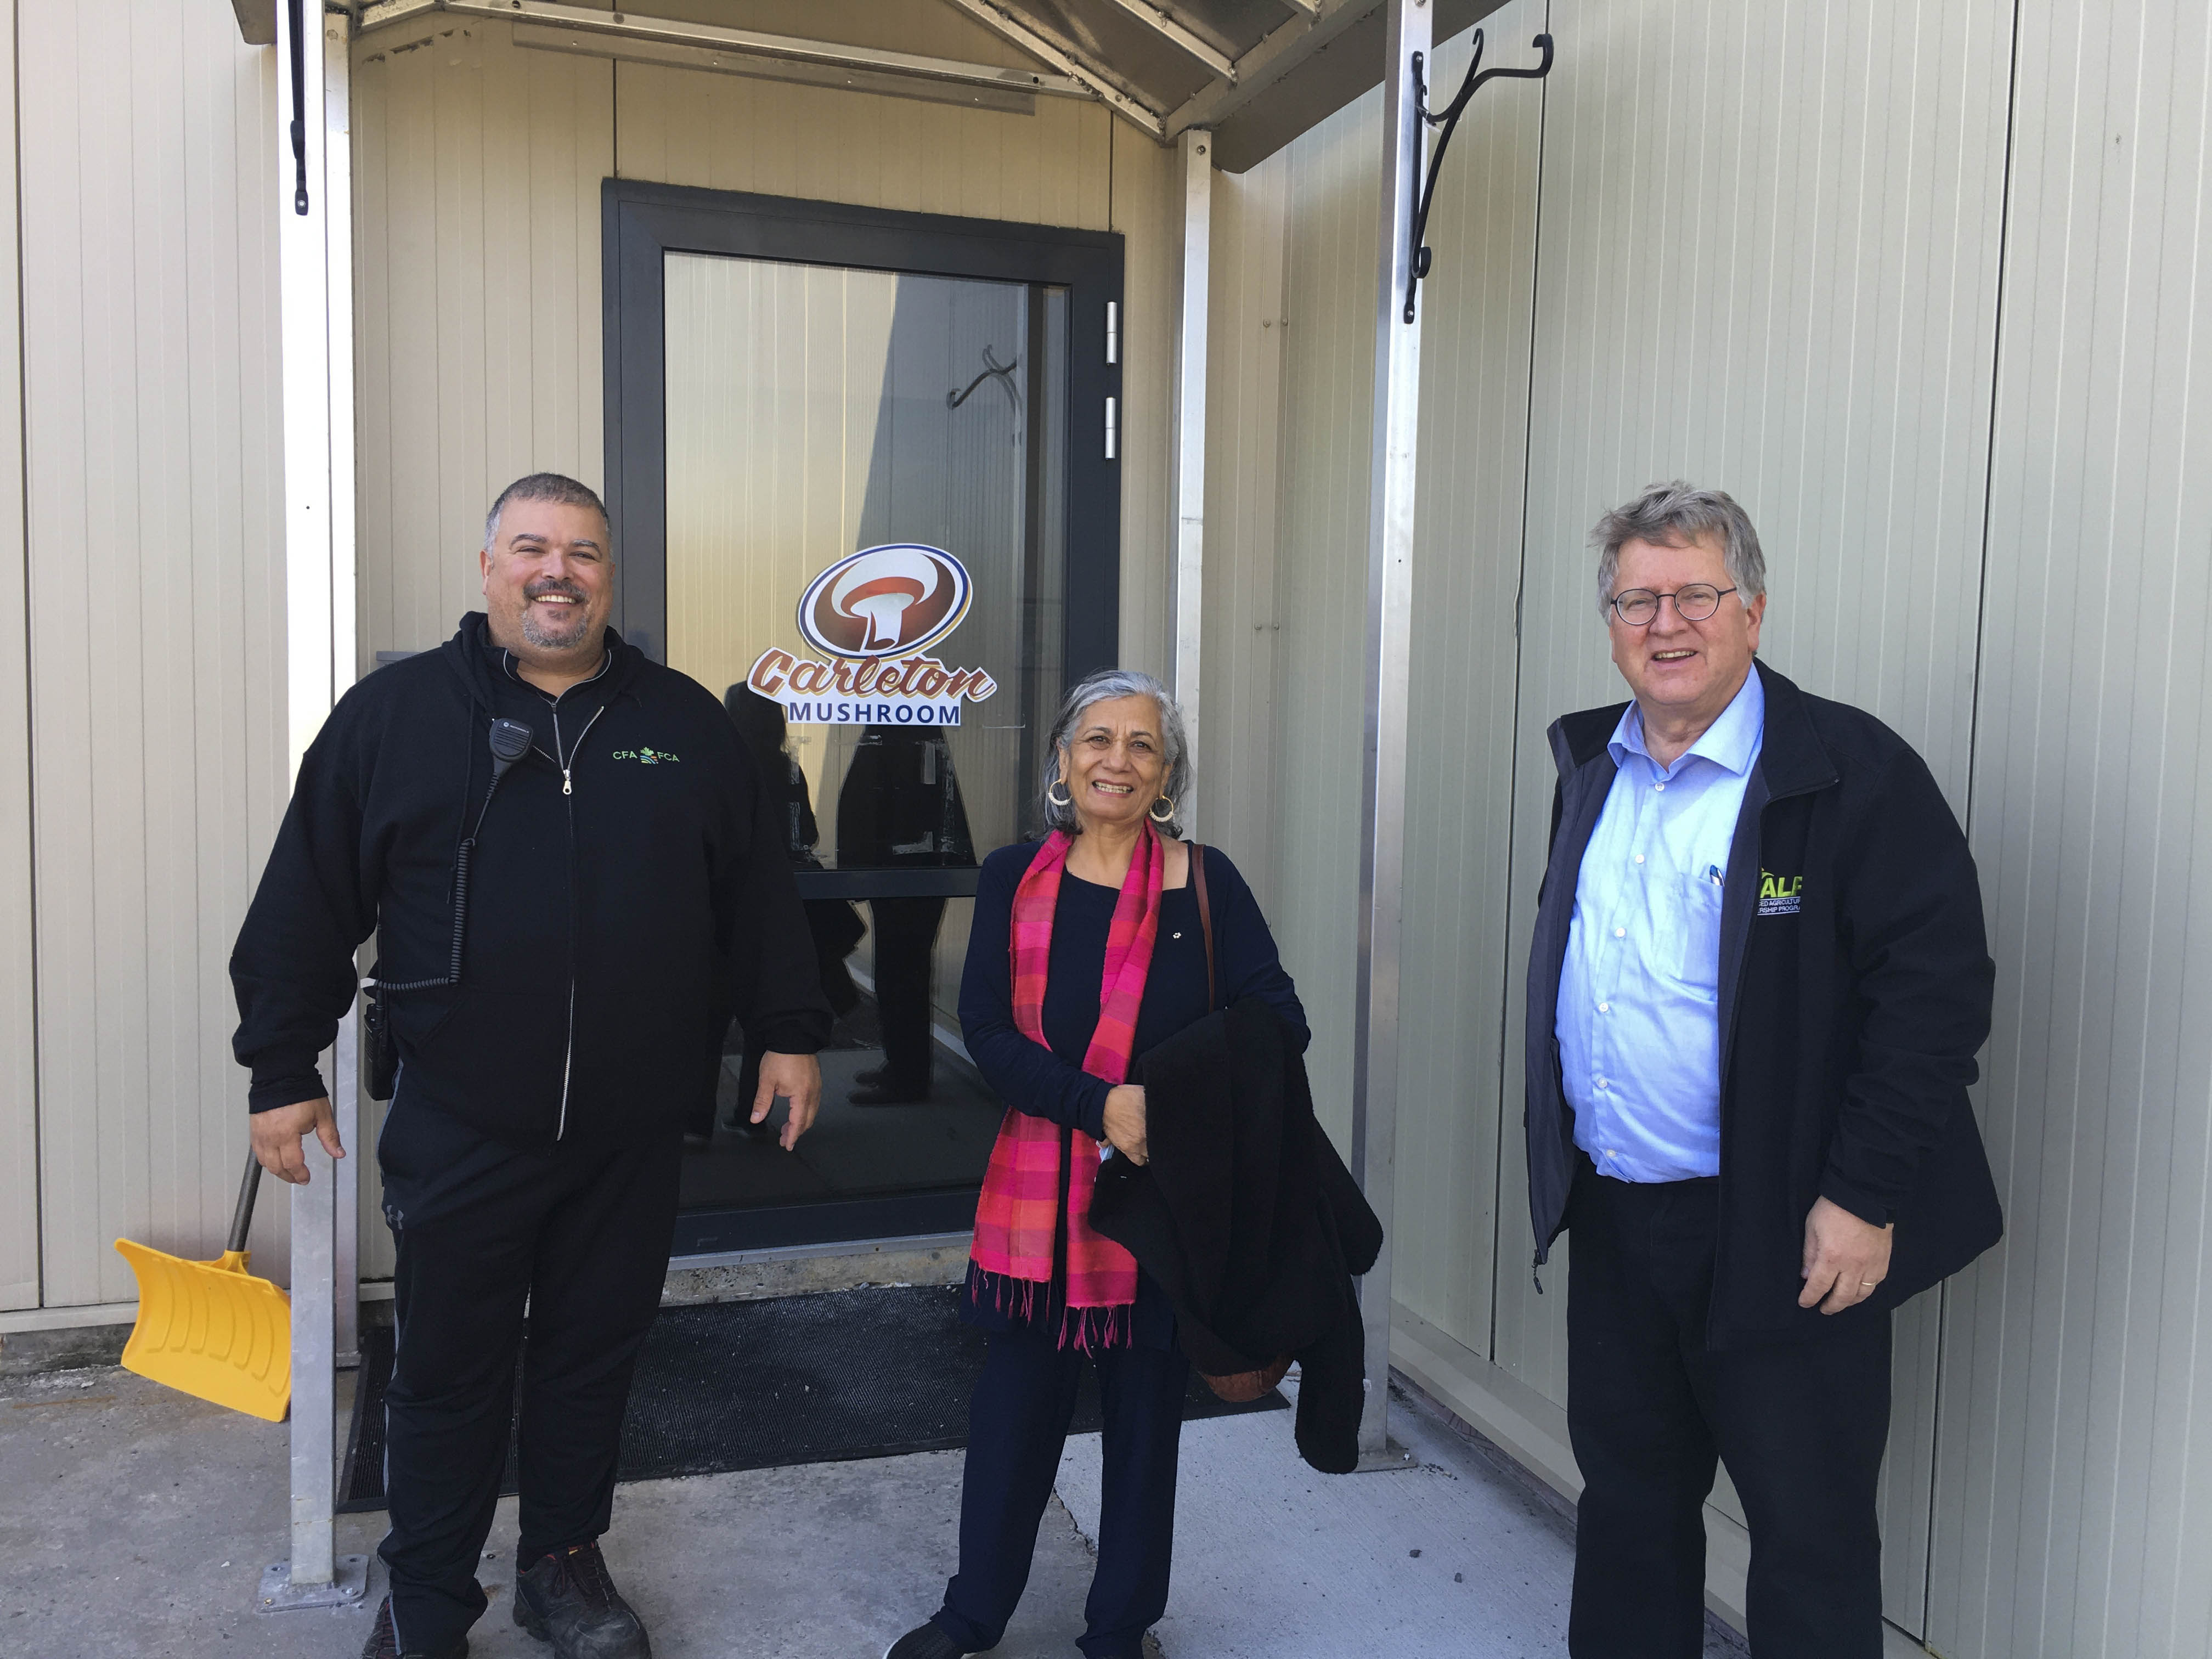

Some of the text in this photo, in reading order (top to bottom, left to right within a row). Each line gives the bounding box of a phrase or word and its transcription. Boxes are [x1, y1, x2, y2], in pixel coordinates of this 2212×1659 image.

[751, 650, 996, 700] Carleton
[789, 702, 960, 724] MUSHROOM
[613, 751, 680, 762] CFA FCA
